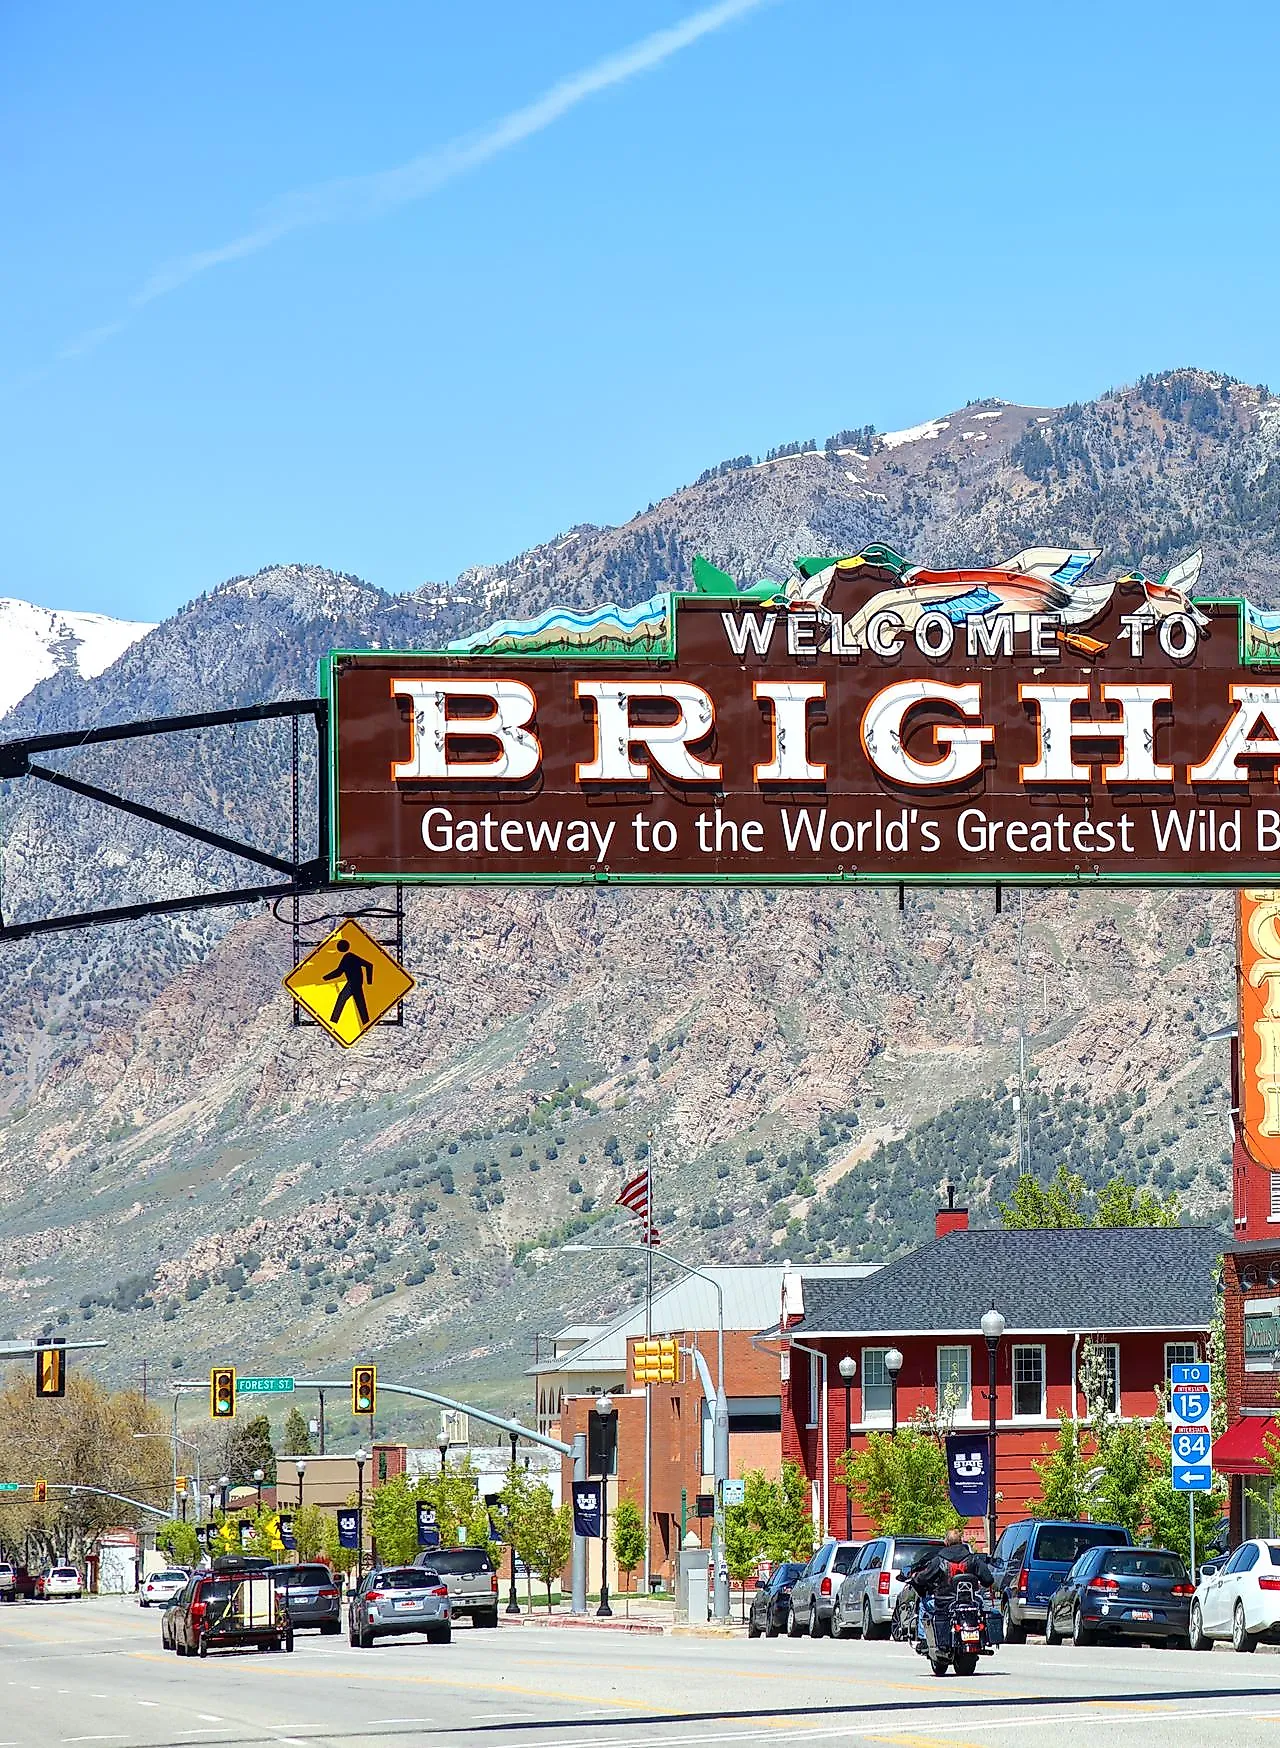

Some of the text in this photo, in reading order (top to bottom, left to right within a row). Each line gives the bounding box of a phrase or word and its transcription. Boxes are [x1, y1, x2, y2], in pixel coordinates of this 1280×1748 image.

[720, 611, 1197, 660] WELCOME TO
[420, 808, 617, 862] Gateway
[632, 813, 678, 853] to
[694, 809, 764, 853] the
[781, 808, 940, 853] World's
[957, 808, 1135, 854] Greatest
[1152, 809, 1243, 853] Wild
[239, 1379, 275, 1390] FOREST
[1181, 1368, 1201, 1380] TO
[1179, 1394, 1203, 1417] 15
[1178, 1435, 1206, 1457] 84
[953, 1460, 984, 1469] STATE
